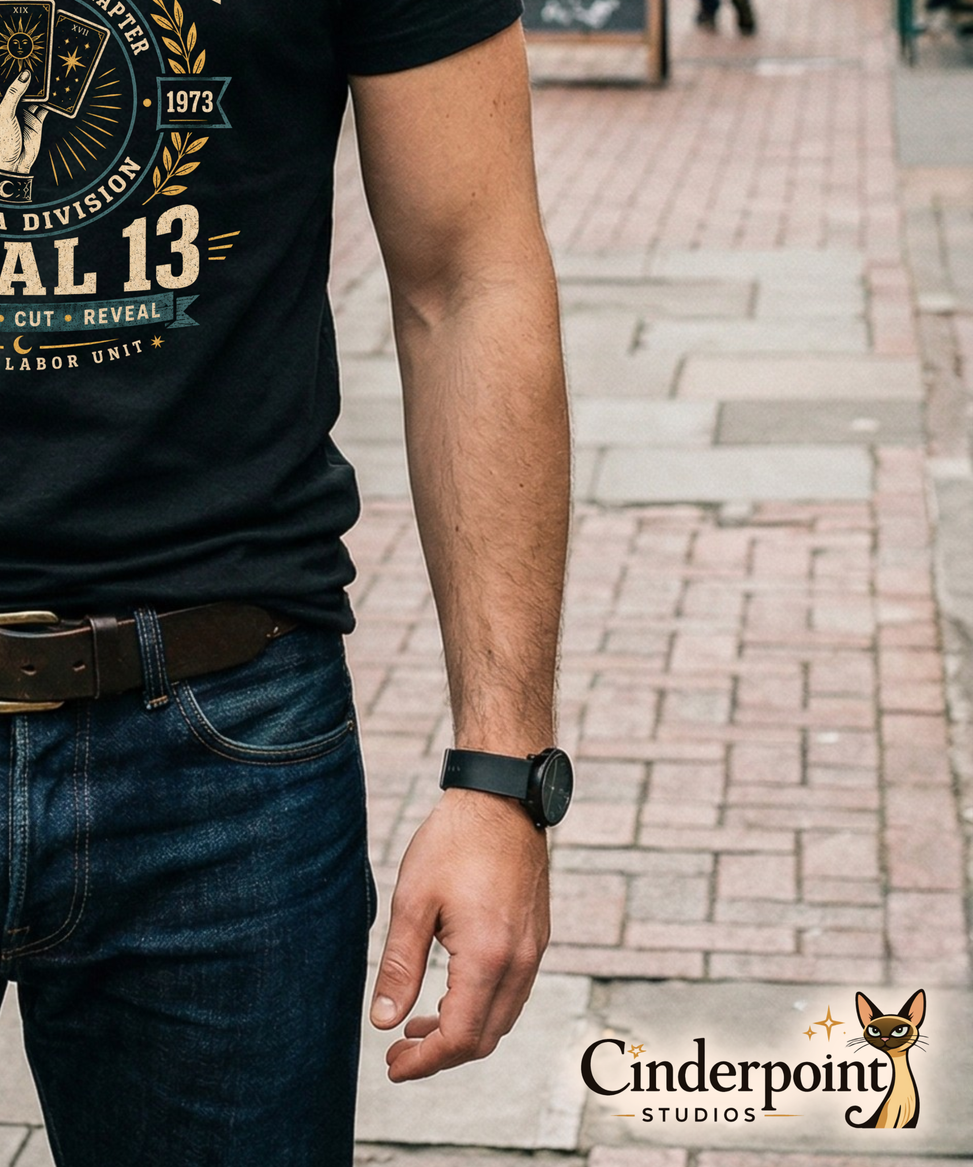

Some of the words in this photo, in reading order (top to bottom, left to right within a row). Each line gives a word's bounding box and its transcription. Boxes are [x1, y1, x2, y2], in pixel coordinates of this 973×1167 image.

[12, 6, 29, 14] XIX
[167, 91, 212, 112] 1973
[22, 156, 142, 232] DIVISION
[122, 204, 201, 293] 13
[15, 311, 53, 326] CUT
[85, 303, 160, 324] REVEAL
[6, 355, 78, 370] LABOR
[92, 340, 143, 364] UNIT
